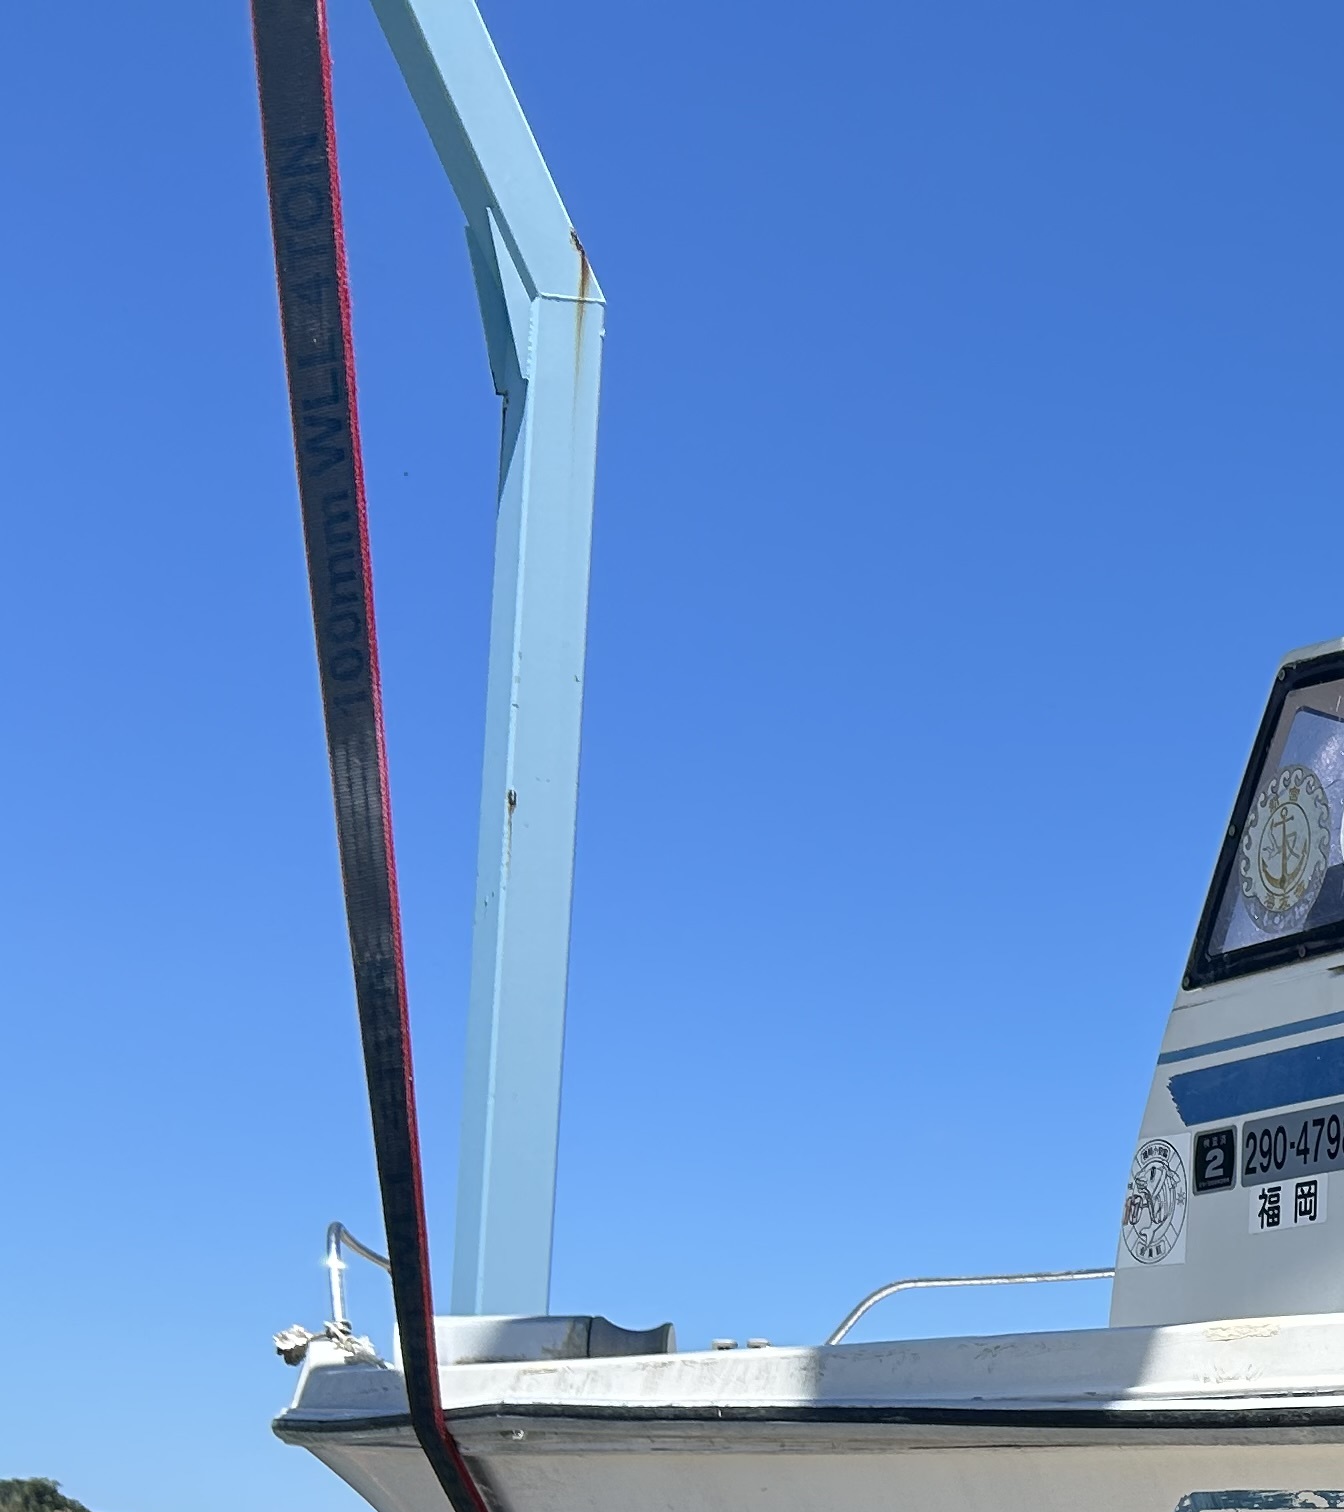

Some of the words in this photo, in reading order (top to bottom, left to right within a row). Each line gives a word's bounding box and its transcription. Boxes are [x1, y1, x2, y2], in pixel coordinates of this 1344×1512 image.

[279, 131, 333, 306] 4TON
[297, 325, 347, 478] WLL
[322, 490, 369, 716] 100mm
[1204, 1148, 1225, 1179] 2
[1258, 1180, 1318, 1230] 福岡
